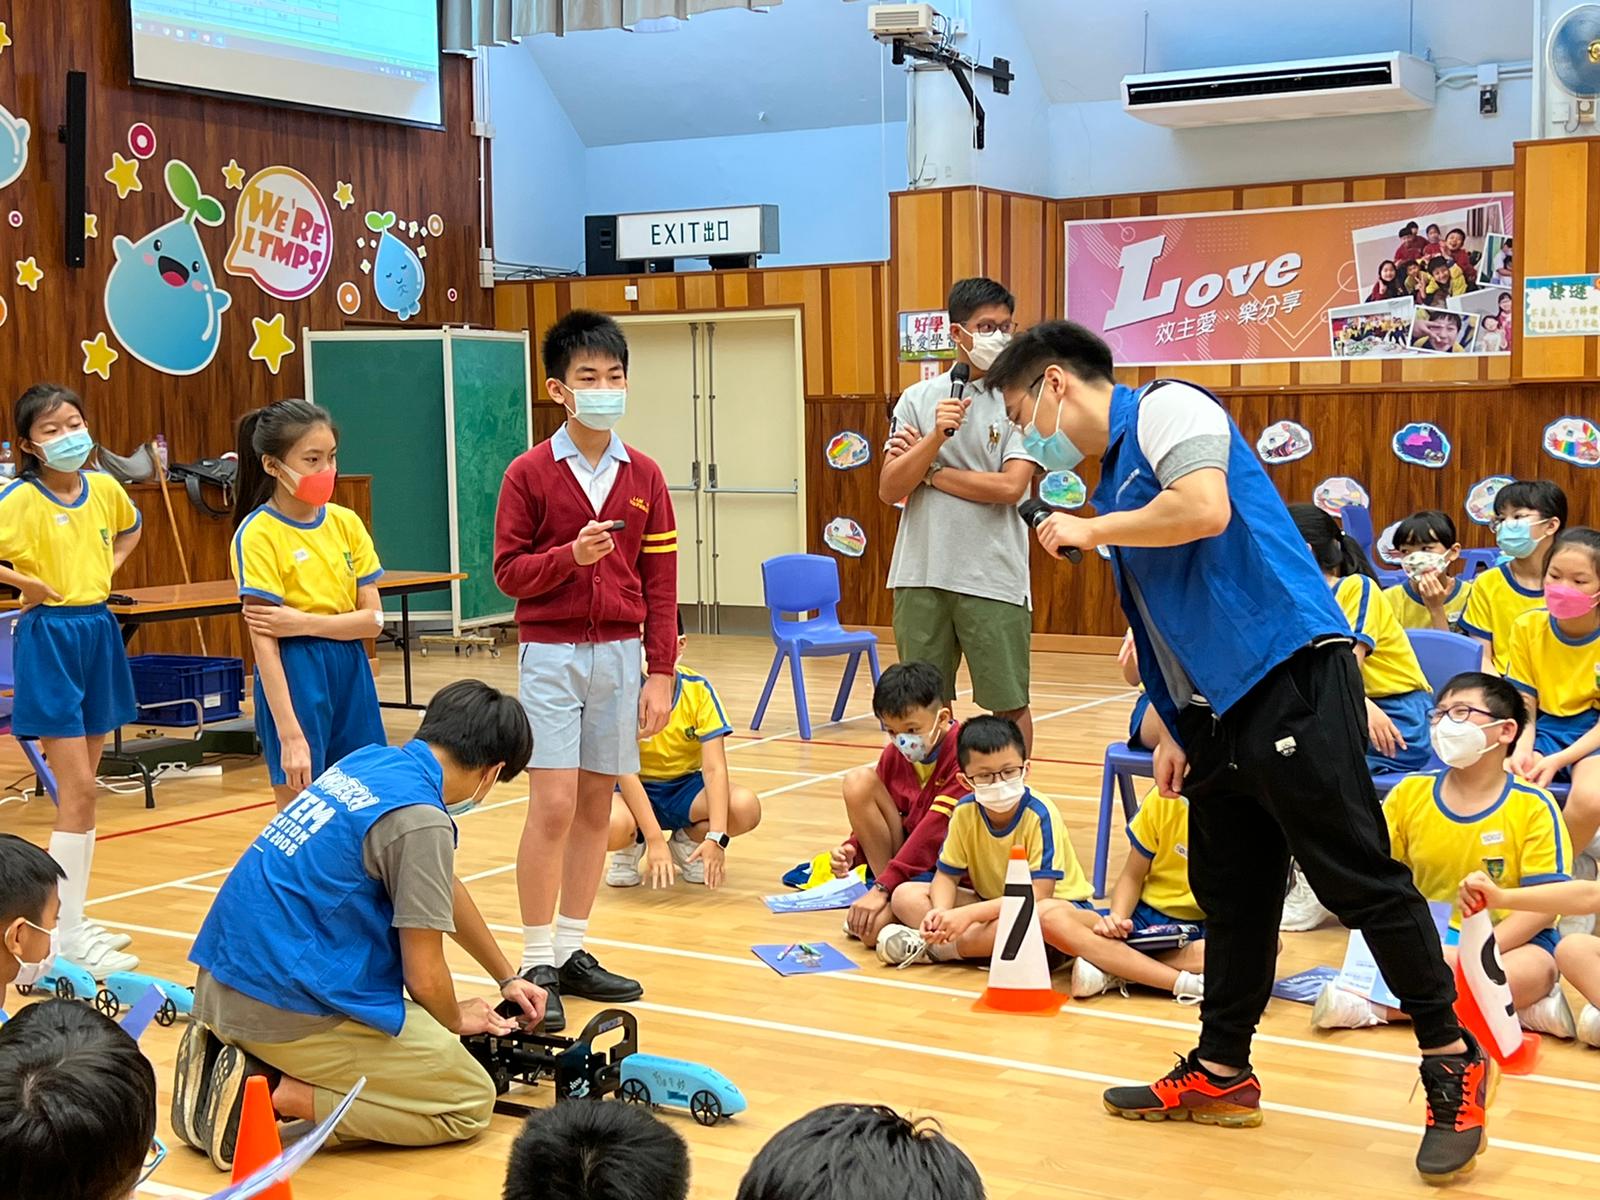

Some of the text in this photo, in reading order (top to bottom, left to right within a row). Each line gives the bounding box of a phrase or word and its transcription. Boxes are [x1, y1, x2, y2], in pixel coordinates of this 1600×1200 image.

[242, 226, 323, 275] LTMPS
[651, 220, 729, 245] EXIT 出口
[1103, 235, 1302, 331] Love
[914, 315, 944, 334] 好學
[1003, 884, 1035, 961] 7
